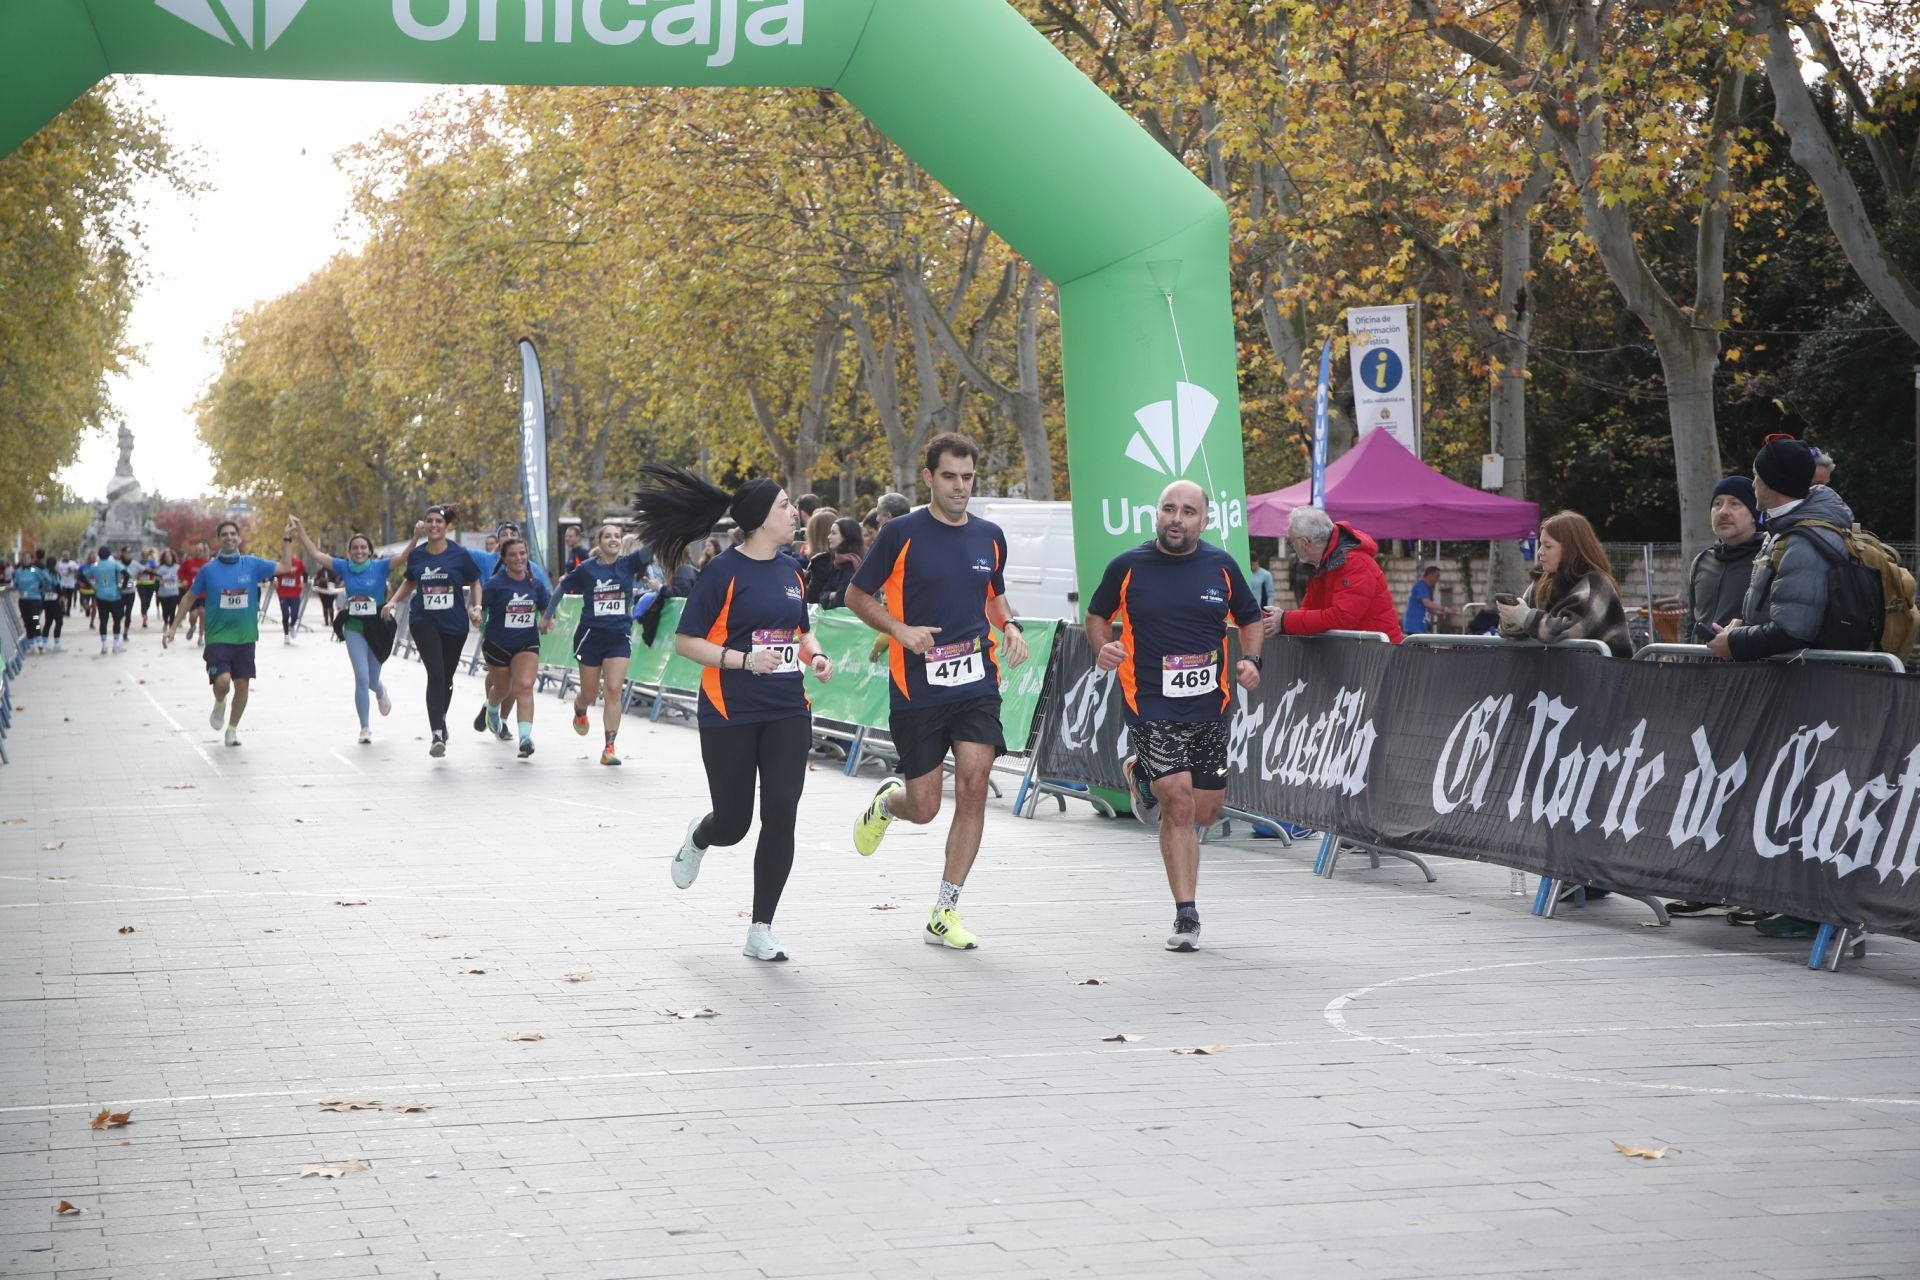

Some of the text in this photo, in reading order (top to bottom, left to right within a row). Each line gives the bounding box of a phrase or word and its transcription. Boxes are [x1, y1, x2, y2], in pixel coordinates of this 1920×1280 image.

[1355, 314, 1391, 324] Oficina de
[1102, 490, 1242, 540] Unaja
[228, 597, 241, 605] 96
[354, 602, 368, 612] 94
[427, 595, 448, 605] 741
[598, 601, 620, 611] 740
[510, 614, 530, 624] 742
[766, 646, 794, 664] 70
[935, 656, 973, 678] 471
[1170, 669, 1210, 688] 469
[1261, 678, 1379, 798] Castilla
[1432, 693, 1513, 815] El
[1507, 690, 1666, 842] Norte
[1666, 724, 1748, 851] de
